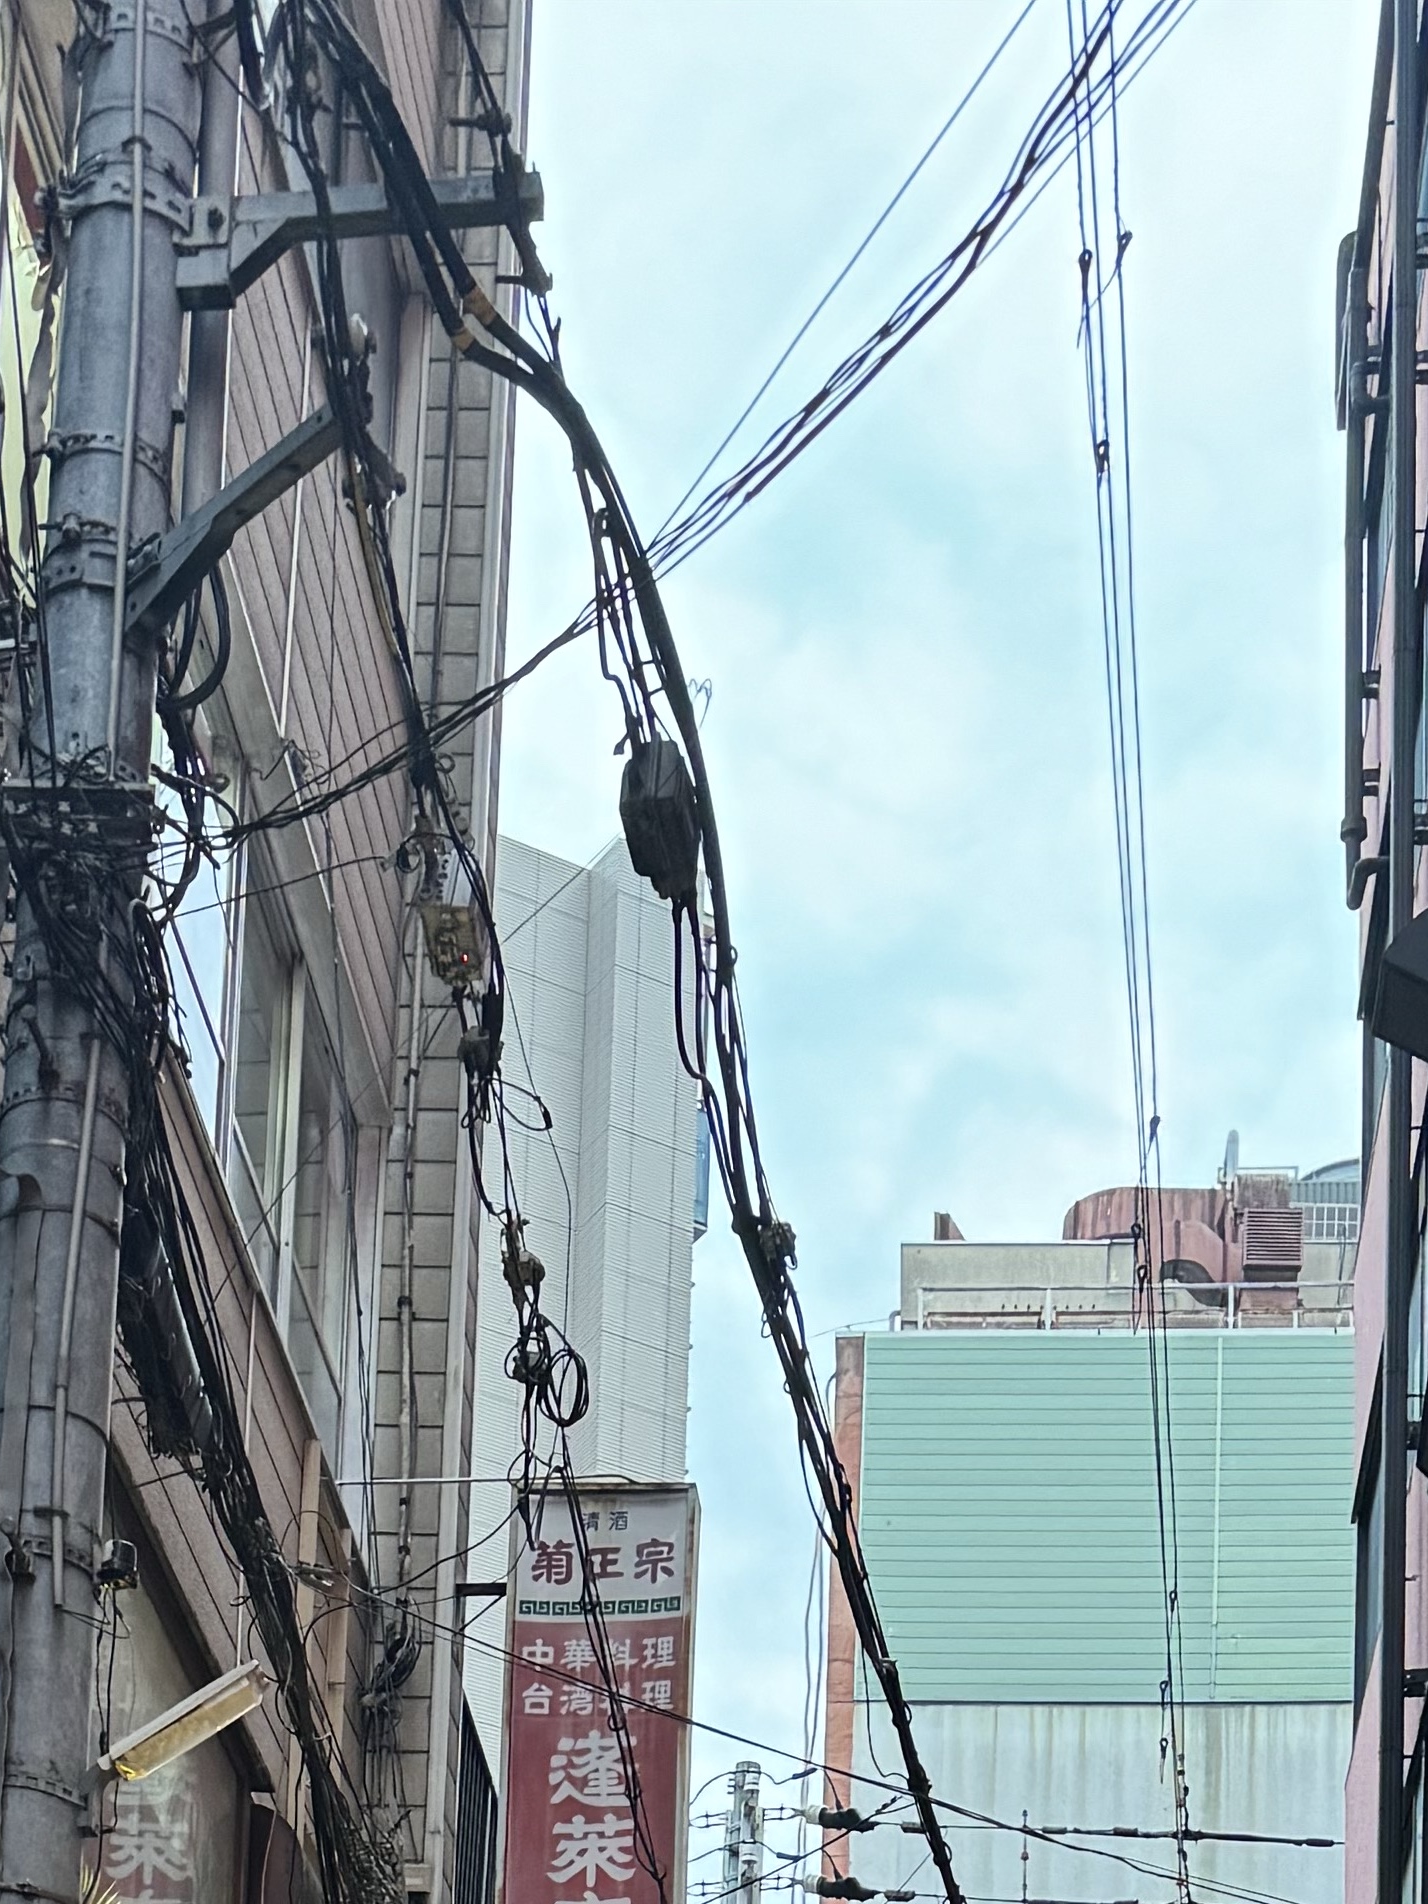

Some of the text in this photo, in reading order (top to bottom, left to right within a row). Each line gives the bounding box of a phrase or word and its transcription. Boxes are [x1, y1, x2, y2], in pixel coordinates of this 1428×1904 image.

[582, 1511, 628, 1531] 清酒
[531, 1538, 675, 1585] 菊正宗
[522, 1636, 676, 1673] 中華料理
